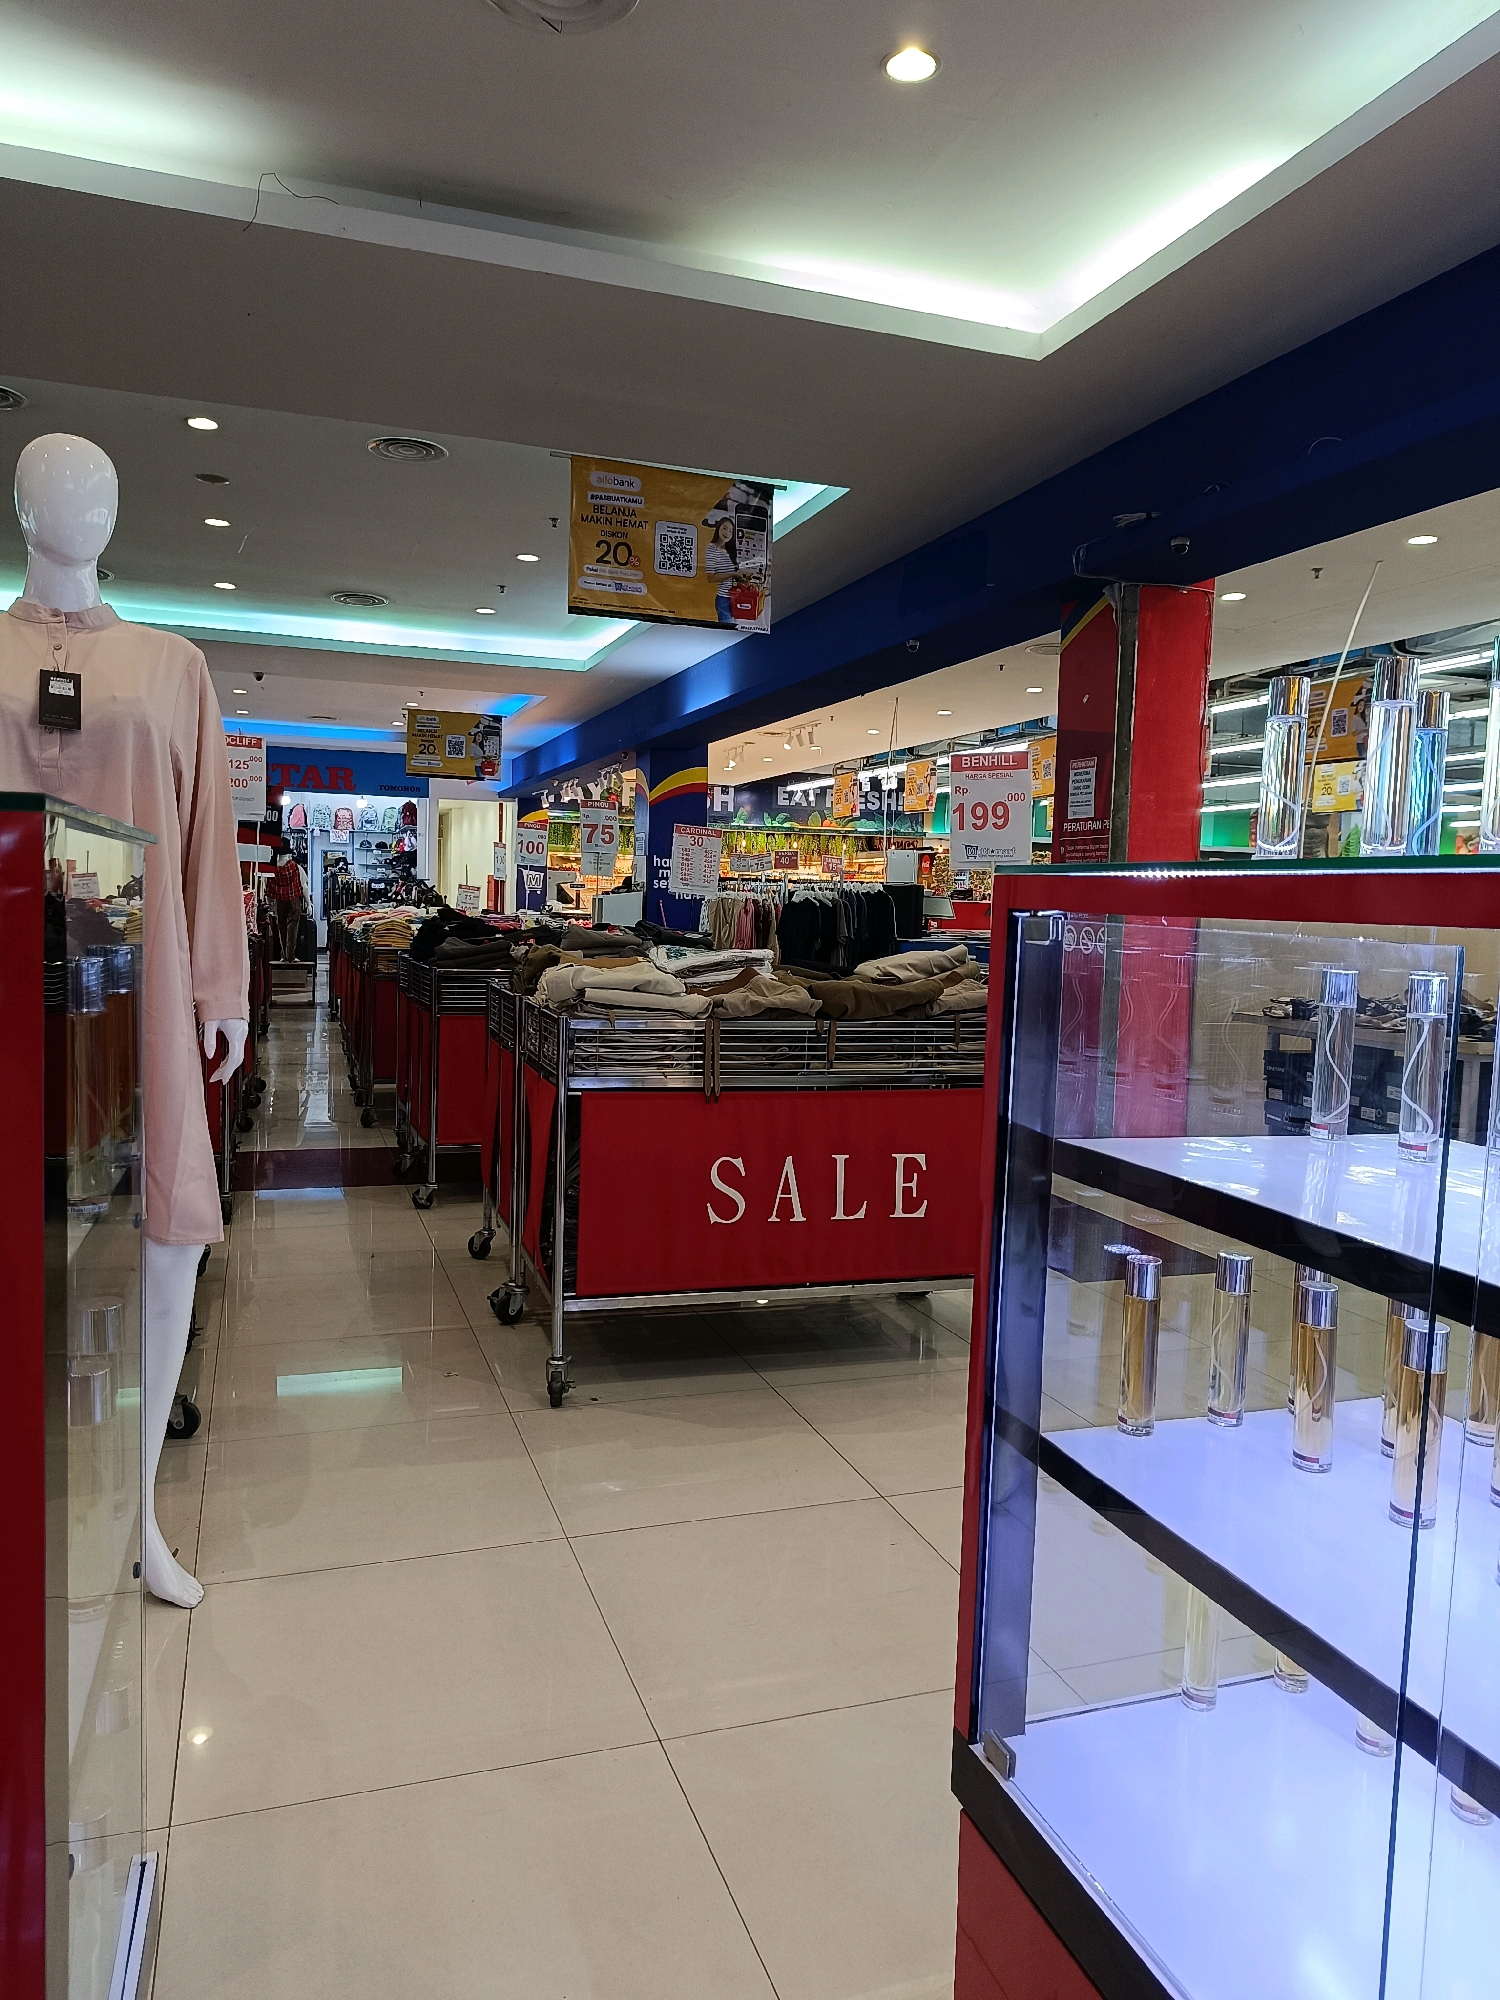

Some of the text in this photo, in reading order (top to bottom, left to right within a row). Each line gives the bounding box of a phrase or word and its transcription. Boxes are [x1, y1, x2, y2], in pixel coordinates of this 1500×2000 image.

[593, 504, 637, 519] BELANJA
[580, 513, 649, 530] MAKIN HEMAT
[600, 529, 629, 540] DISKON
[961, 754, 1018, 768] BENHILL
[965, 772, 1014, 781] HARGA SPESIAL
[378, 784, 421, 792] TOMOHON
[952, 800, 1011, 832] 199
[1004, 792, 1026, 803] .000
[680, 826, 717, 836] CARDINAL
[1063, 820, 1102, 832] PERATURAN
[582, 823, 614, 845] 75
[518, 839, 545, 855] 100
[689, 835, 704, 848] 30
[754, 861, 765, 870] 75
[780, 856, 790, 865] 40
